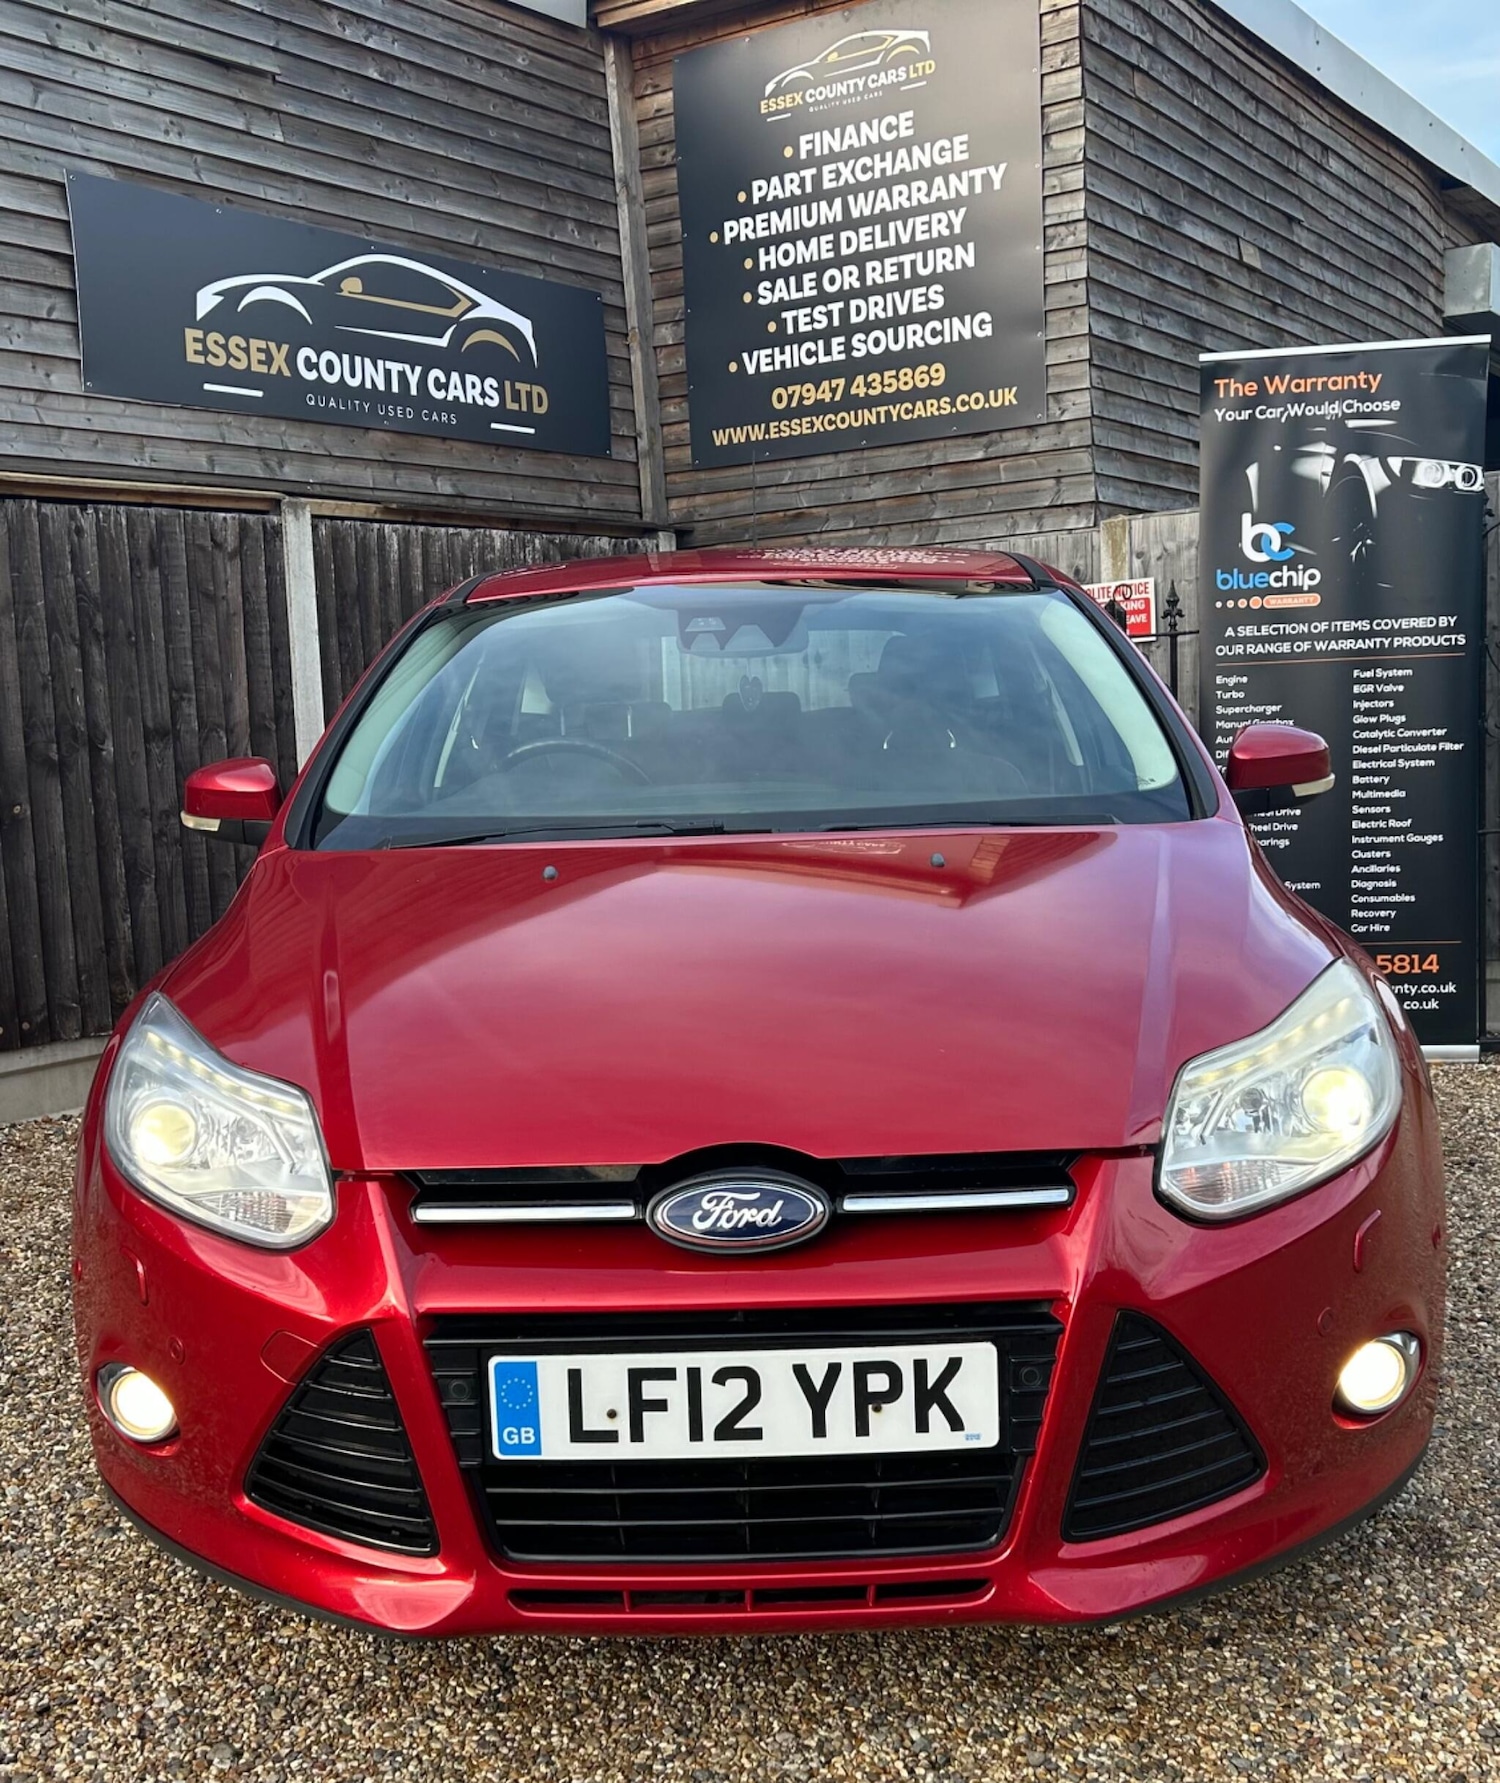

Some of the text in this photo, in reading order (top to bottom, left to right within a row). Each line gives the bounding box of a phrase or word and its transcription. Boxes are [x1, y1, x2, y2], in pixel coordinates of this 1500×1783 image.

[760, 59, 936, 114] ESSEX COUNTY CARS LTD
[799, 110, 914, 160] FINANCE
[752, 134, 969, 204] PART EXCHANGE
[724, 163, 1008, 245] PREMIUM WARRANTY
[758, 207, 968, 272] HOME DELIVERY
[757, 242, 975, 306] SALE OR RETURN
[781, 284, 945, 335] TEST DRIVES
[742, 311, 993, 375] VEHICLE SOURCING
[184, 327, 548, 415] ESSEX COUNTY CARS LTD
[772, 362, 946, 410] 07947 435869
[1214, 371, 1382, 398] The Warranty
[306, 393, 458, 425] QUALITY USED CARS
[1214, 399, 1401, 422] Your Car Would Choose
[712, 386, 1018, 446] WWW.ESSEXCOUNTYCARS.CO.UK
[1216, 564, 1321, 591] bluechip
[1269, 597, 1314, 605] WARRANTY
[1224, 616, 1457, 638] A SELECTION OF ITEMS COVERED BY
[1215, 634, 1466, 656] OUR RANGE OF WARRANTY PRODUCTS
[1353, 668, 1413, 679] Fuel System
[1216, 675, 1248, 686] Engine
[1216, 690, 1245, 699] Turbo
[1353, 683, 1404, 694] EGR Valve
[1216, 705, 1282, 715] Supercharger
[1353, 700, 1395, 711] Injectors
[1353, 714, 1406, 725] Glow Plugs
[1352, 728, 1447, 740] Catalytic Converter
[1352, 742, 1464, 754] Diesel Particulate Filter
[1352, 759, 1435, 770] Electrical System
[1352, 775, 1390, 785] Battery
[1352, 789, 1406, 799] Multimedia
[1352, 805, 1391, 814] Sensors
[1272, 822, 1298, 831] Drive
[1352, 818, 1412, 829] Electric Roof
[1352, 833, 1444, 845] Instrument Gauges
[1351, 850, 1391, 859] Clusters
[1351, 864, 1401, 873] Ancillaries
[1284, 881, 1321, 892] System
[1351, 879, 1397, 891] Diagnosis
[1351, 893, 1416, 903] Consumables
[1351, 909, 1396, 919] Recovery
[1351, 924, 1390, 933] Car Hire
[692, 1191, 784, 1231] Ford
[567, 1357, 965, 1444] LF12 YPK
[503, 1426, 536, 1445] GB
